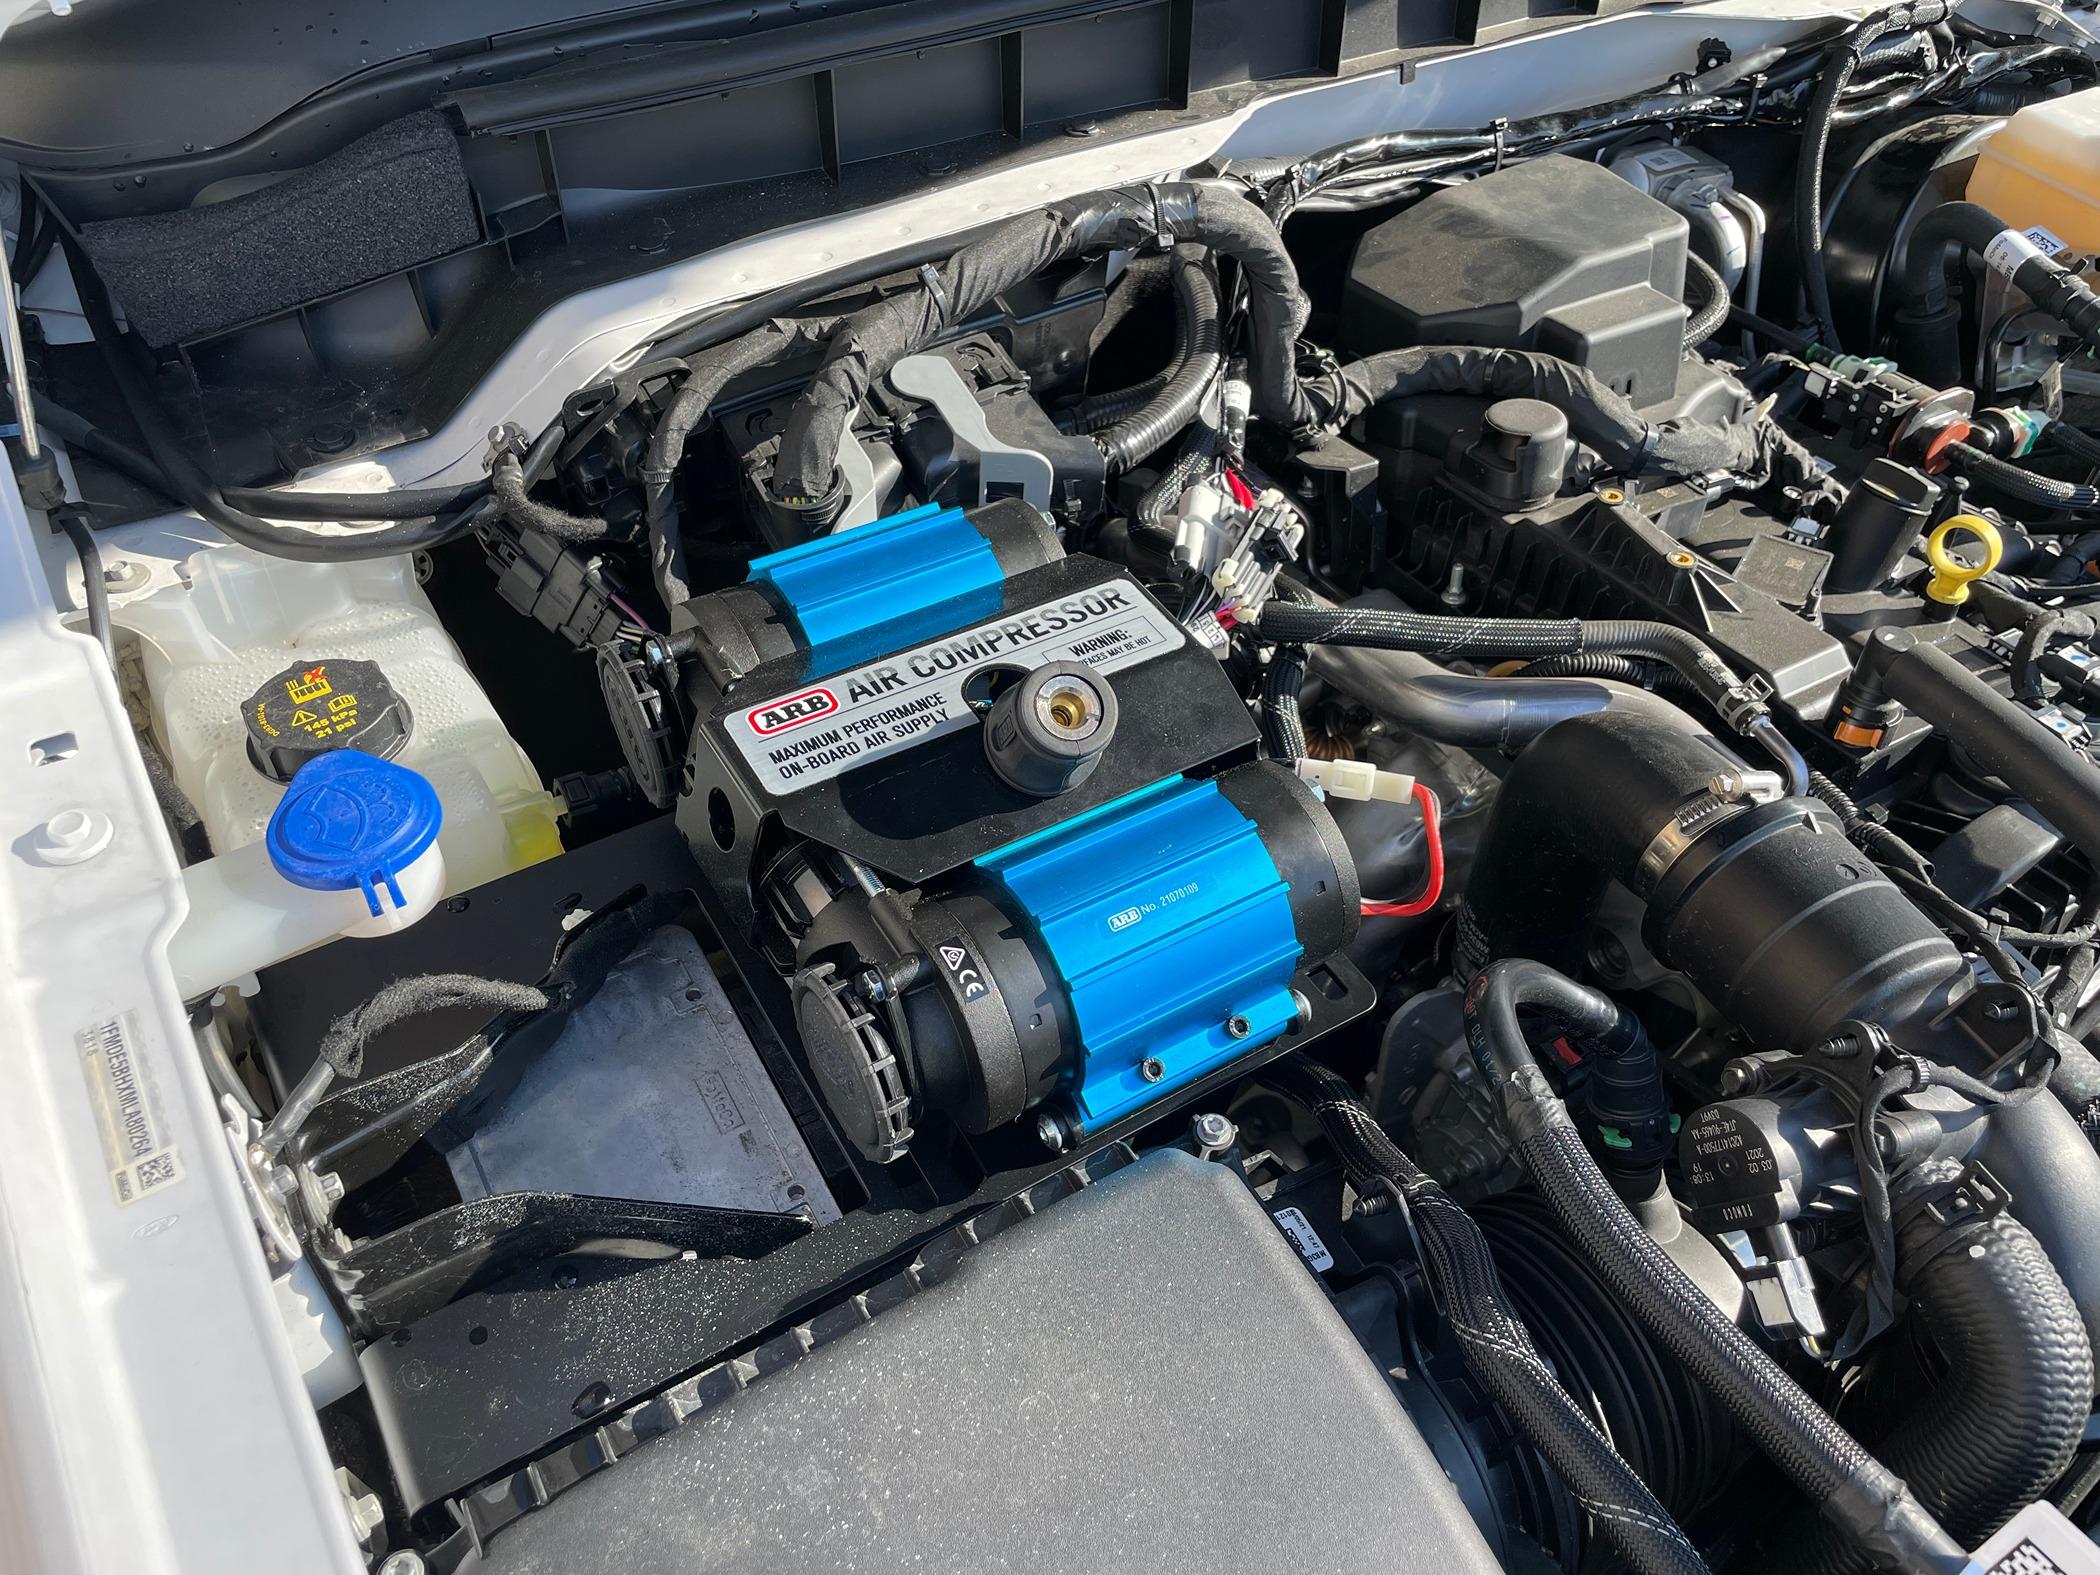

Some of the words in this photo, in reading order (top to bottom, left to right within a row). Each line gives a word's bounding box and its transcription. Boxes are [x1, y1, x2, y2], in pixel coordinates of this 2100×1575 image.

[846, 664, 907, 704] AIR
[907, 587, 1131, 679] COMPRESSOR
[1068, 629, 1133, 657] WARNING:
[1108, 645, 1125, 658] MAY
[1125, 640, 1137, 651] BE
[1136, 635, 1152, 647] HOT
[304, 718, 331, 732] 145
[331, 709, 359, 723] kPa
[762, 695, 830, 728] ARB
[315, 728, 333, 739] 21
[335, 718, 357, 733] psi
[768, 729, 843, 765] MAXIMUM
[842, 691, 948, 739] PERFORMANCE
[779, 741, 861, 780] ON-BOARD
[864, 730, 892, 750] AIR
[894, 708, 951, 738] SUPPLY
[1111, 910, 1139, 929] ARB
[1140, 903, 1160, 915] No.
[1160, 882, 1199, 907] 21070109
[1745, 1147, 1765, 1160] 2021
